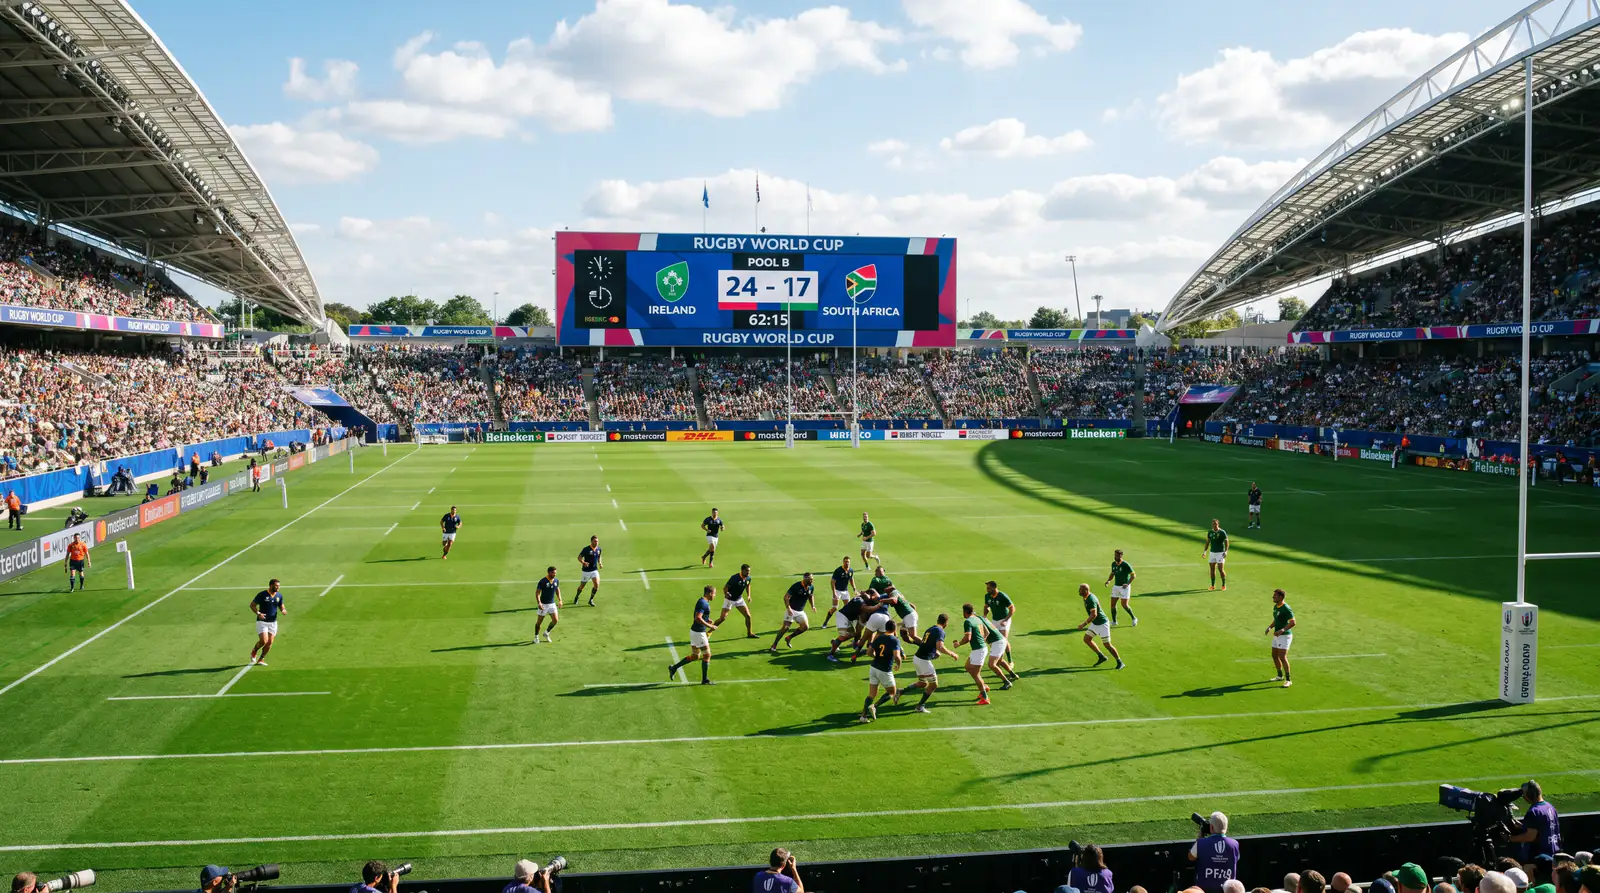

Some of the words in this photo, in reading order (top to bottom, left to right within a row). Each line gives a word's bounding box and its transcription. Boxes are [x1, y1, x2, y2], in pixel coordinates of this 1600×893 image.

[693, 237, 747, 250] RUGBY
[750, 238, 809, 251] WORLD
[813, 239, 844, 251] CUP
[748, 258, 779, 267] POOL
[782, 258, 790, 267] B
[726, 276, 758, 297] 24
[783, 277, 811, 297] 17
[648, 305, 697, 315] IRELAND
[822, 306, 860, 316] SOUTH
[861, 307, 900, 316] AFRICA
[9, 309, 29, 320] RUGBY
[30, 311, 52, 322] WORLD
[52, 313, 64, 324] CUP
[749, 314, 789, 326] 62:15
[1370, 331, 1391, 339] WORLD
[1486, 326, 1510, 335] RUGBY
[1510, 325, 1538, 334] WOD
[1539, 324, 1554, 333] CUP
[703, 332, 750, 344] RUGBY
[807, 334, 834, 344] CUP
[486, 433, 534, 442] Heineken
[758, 431, 808, 439] masteard
[1071, 429, 1117, 438] Heineken
[1360, 449, 1390, 461] Heineken
[107, 509, 139, 535] mastercard
[879, 644, 886, 657] 2
